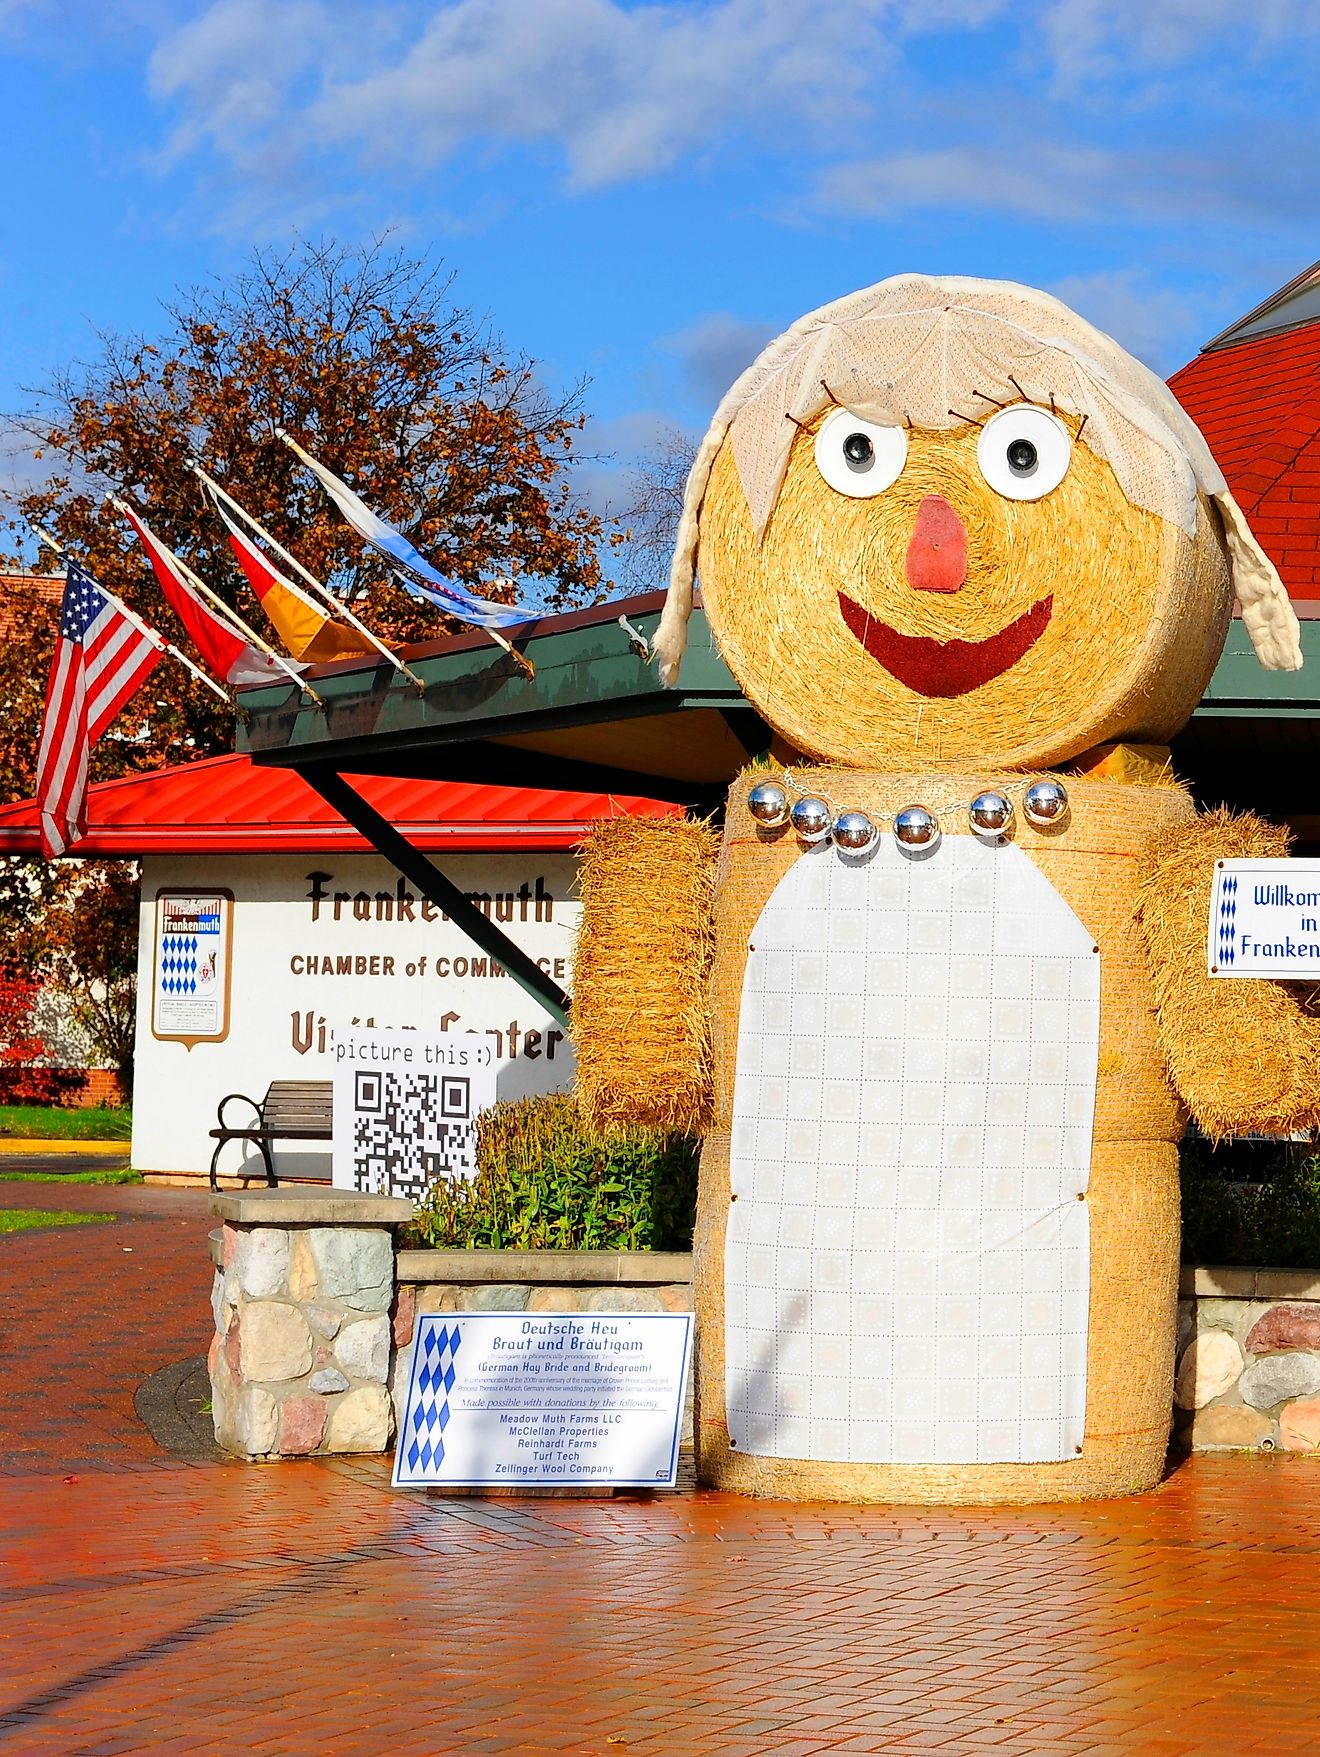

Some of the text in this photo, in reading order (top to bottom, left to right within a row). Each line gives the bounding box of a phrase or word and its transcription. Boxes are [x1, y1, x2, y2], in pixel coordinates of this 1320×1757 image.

[305, 871, 554, 923] Frankemuth
[164, 915, 220, 933] Frankenmuth
[1301, 914, 1317, 932] in
[290, 955, 566, 980] CHAMBER of COMMCE
[440, 1010, 565, 1061] nter
[336, 1038, 413, 1063] picture
[425, 1041, 468, 1066] this
[521, 1321, 618, 1335] Deutsche Heu
[493, 1336, 643, 1354] Braut und Bräutigam
[479, 1361, 652, 1374] (German Hay Bride and Bridegroom)
[462, 1399, 484, 1407] Made
[486, 1399, 521, 1409] possible
[523, 1399, 542, 1407] with
[545, 1399, 586, 1407] donations
[589, 1399, 600, 1409] by
[602, 1399, 617, 1407] the
[499, 1415, 622, 1424] Meadow Muth Farms LLC
[509, 1427, 609, 1438] McClellan Properties
[518, 1439, 597, 1448] Reinhardt Farms
[533, 1451, 580, 1460] Turf Tech
[542, 1464, 566, 1473] Wool
[570, 1464, 614, 1475] Company
